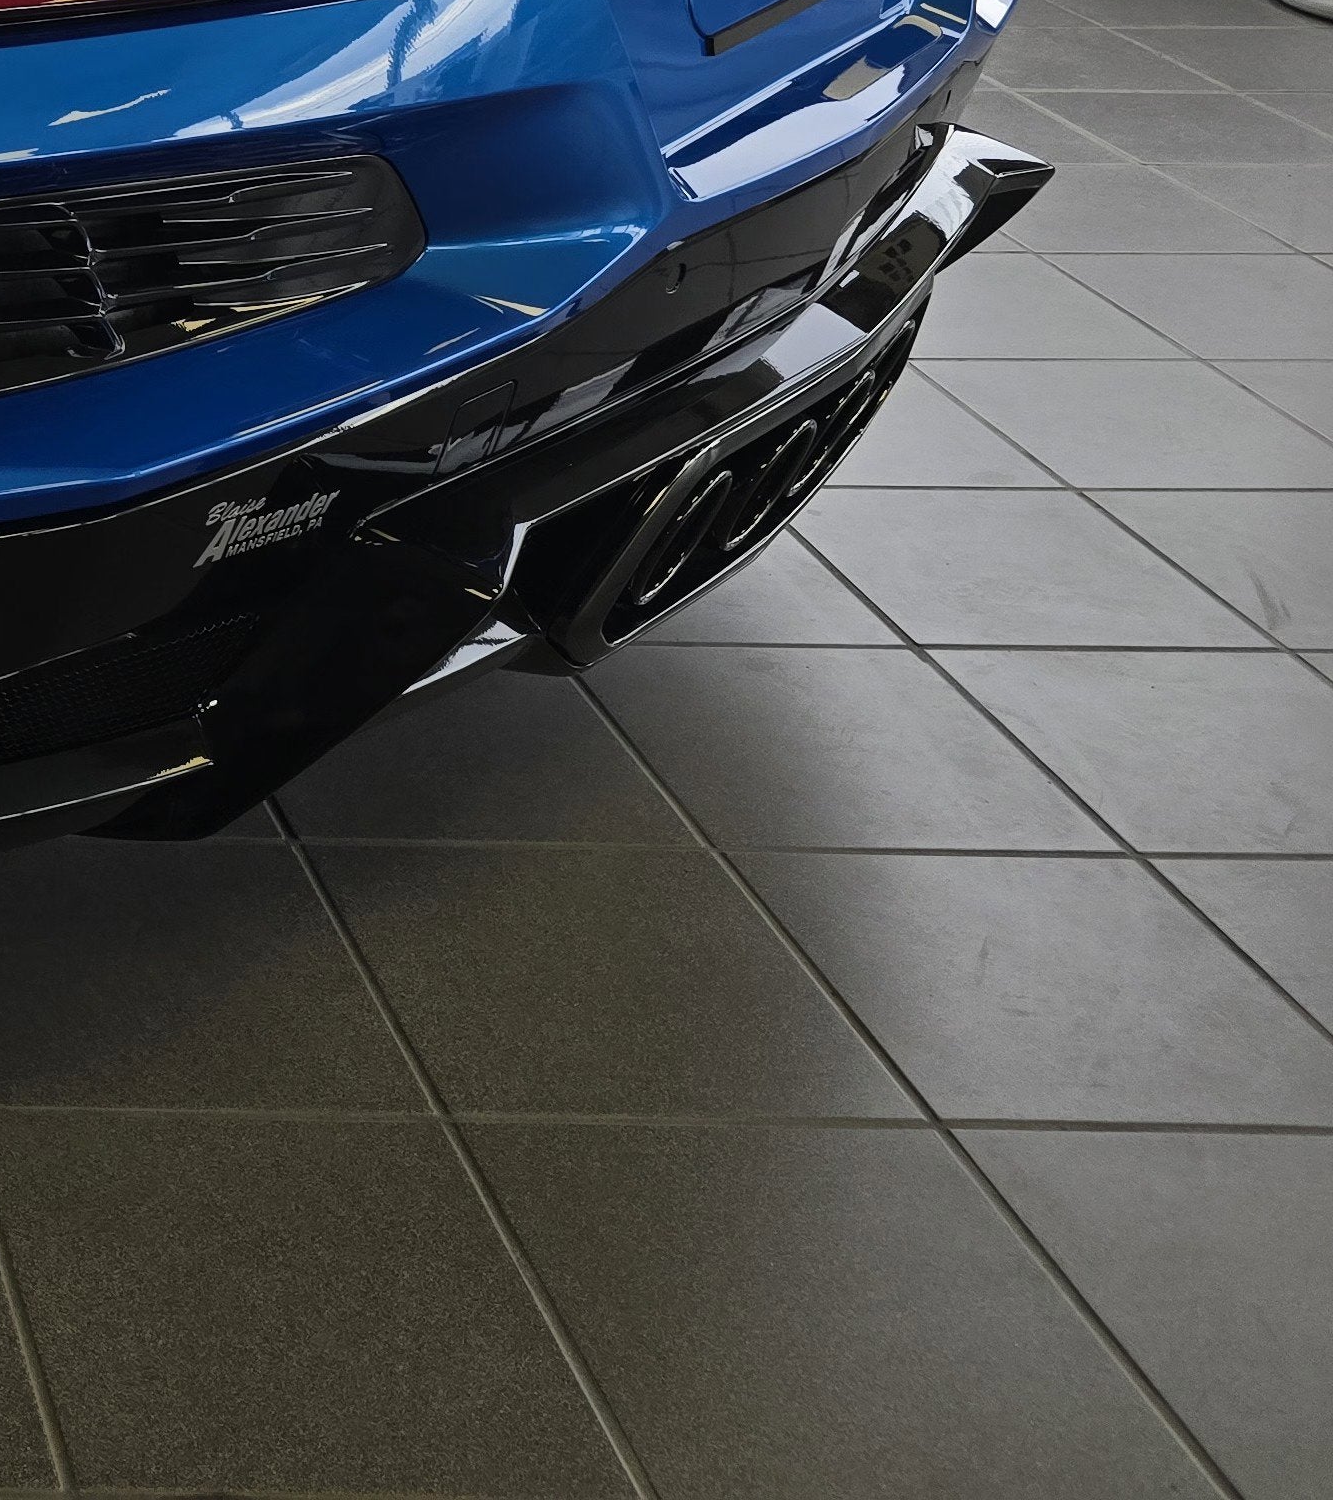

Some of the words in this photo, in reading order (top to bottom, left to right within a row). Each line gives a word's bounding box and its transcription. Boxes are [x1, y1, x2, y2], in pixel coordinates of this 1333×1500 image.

[192, 489, 341, 569] Alexander
[205, 496, 267, 526] Blaise
[225, 524, 303, 559] MANSFIELD,
[306, 516, 323, 532] PA
